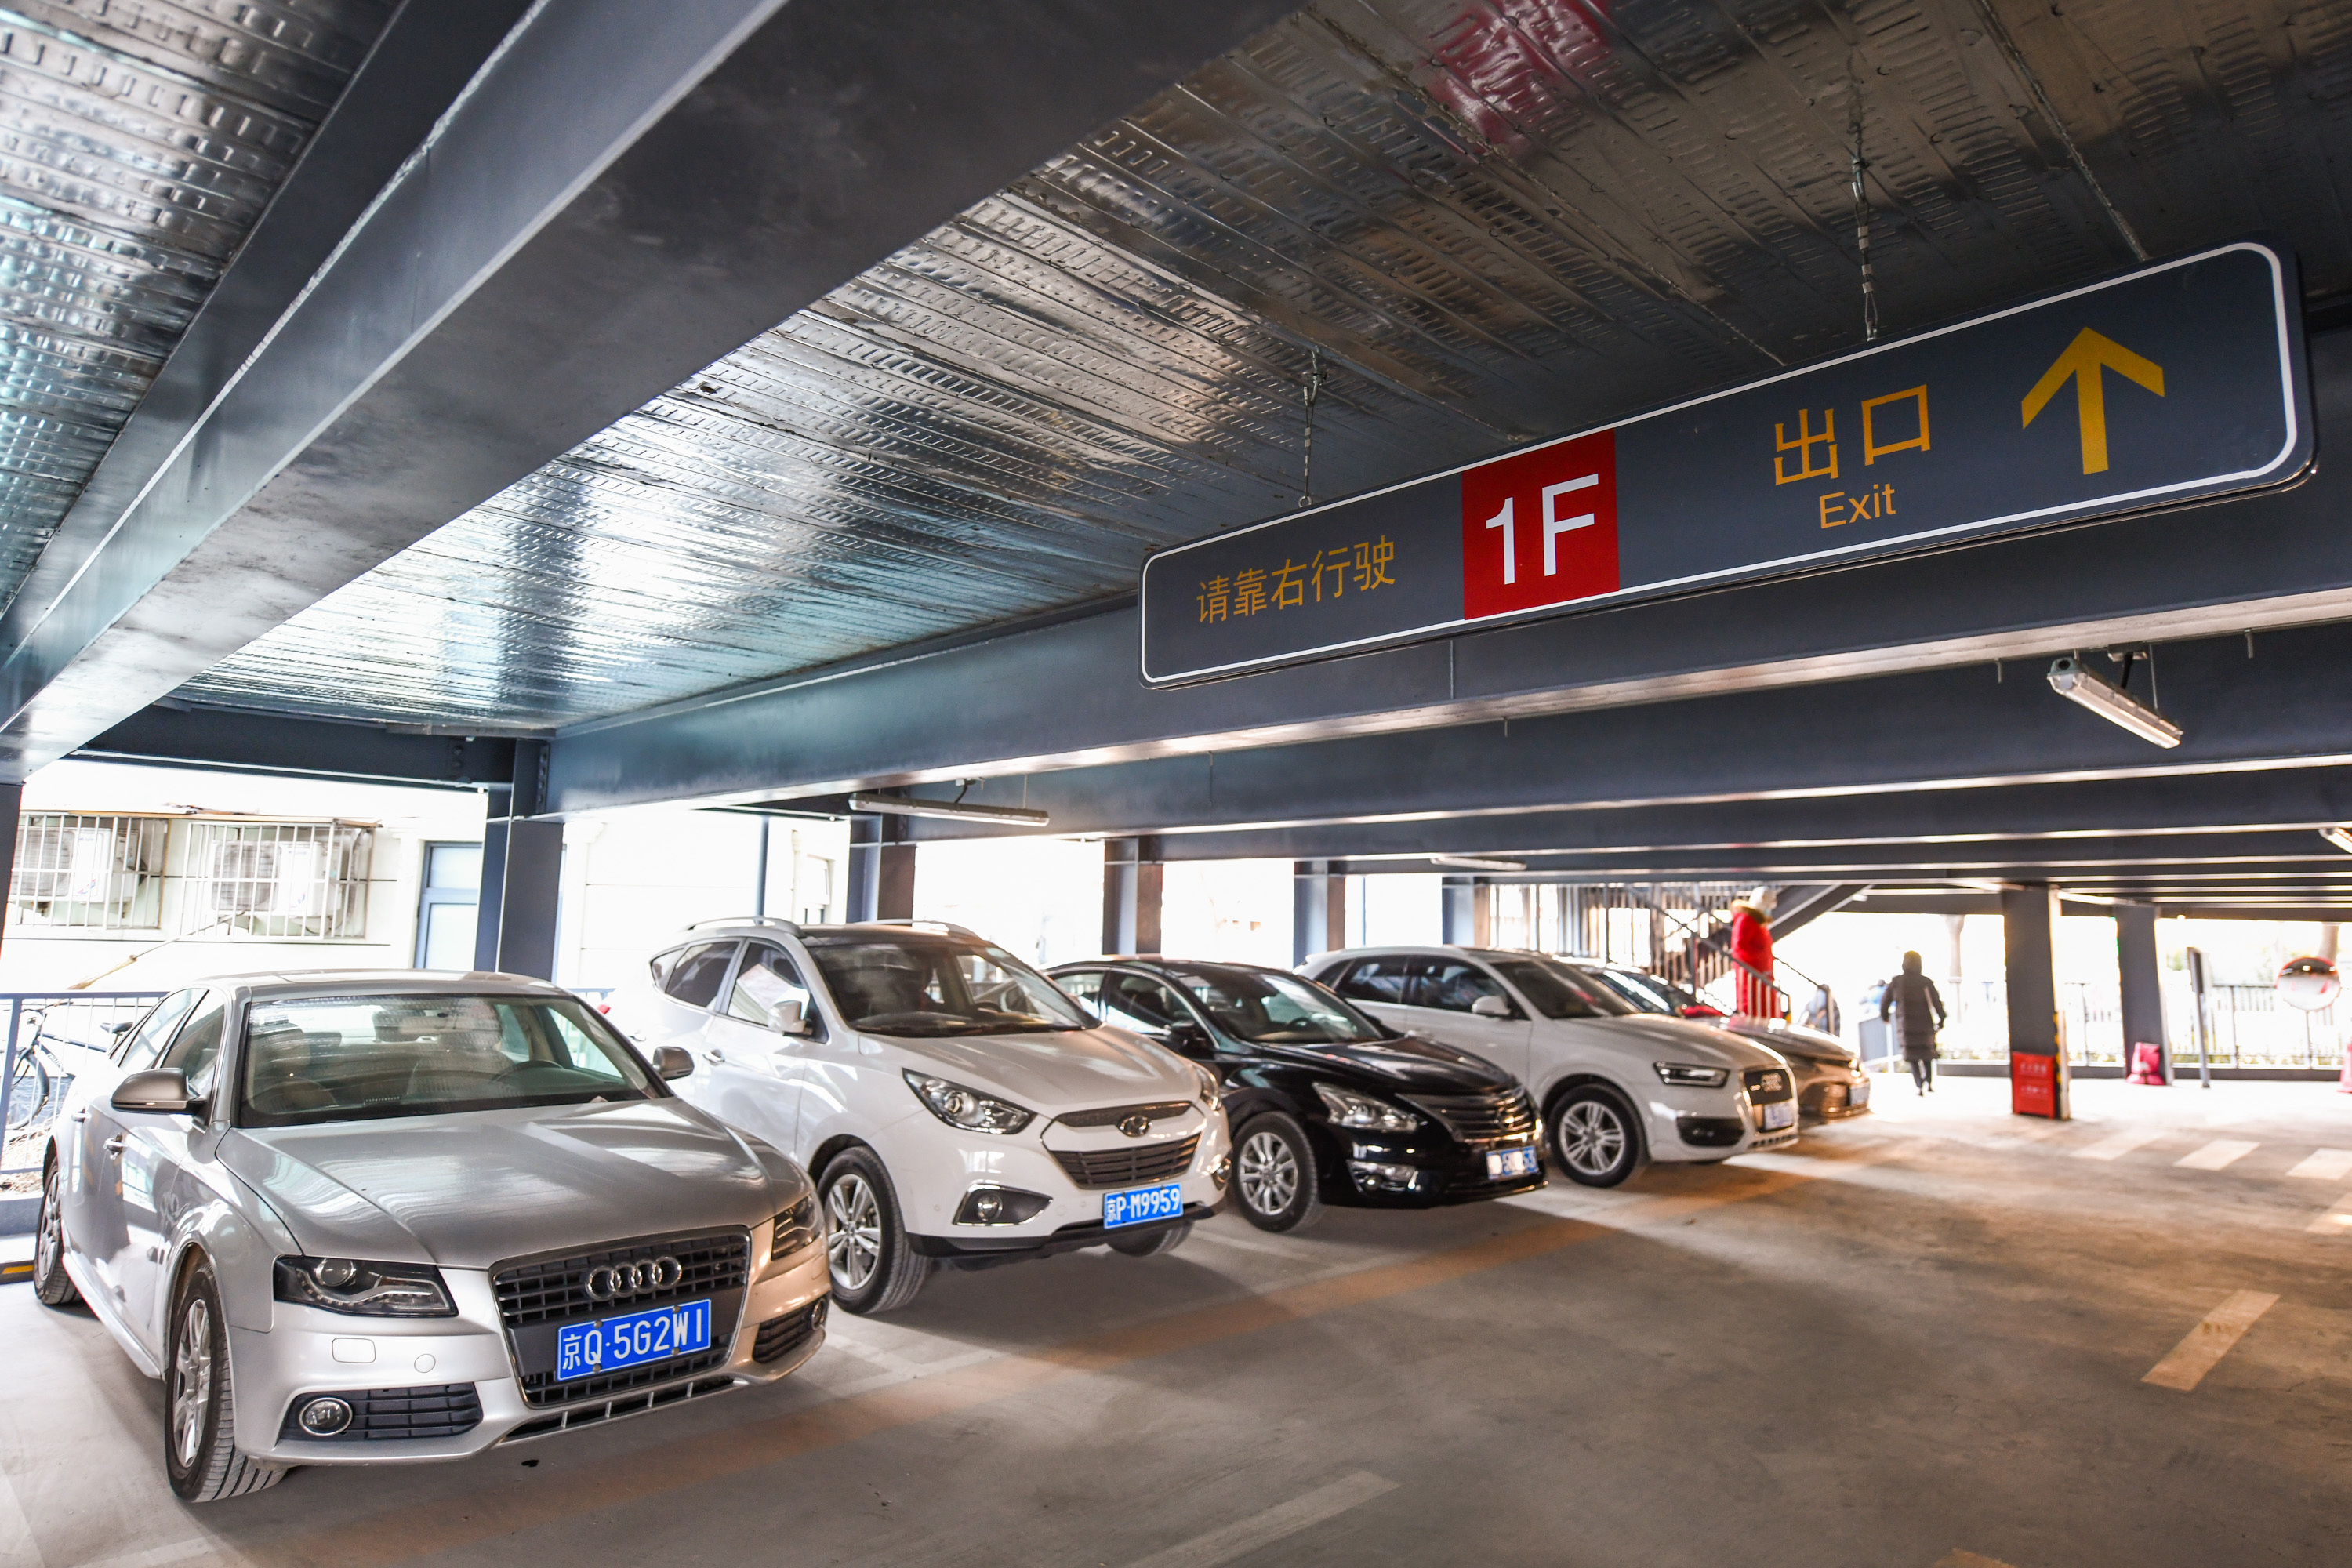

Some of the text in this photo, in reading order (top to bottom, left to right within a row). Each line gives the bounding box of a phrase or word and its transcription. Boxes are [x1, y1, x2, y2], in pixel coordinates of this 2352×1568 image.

[1774, 383, 1930, 486] 出口
[1486, 473, 1599, 585] 1F
[1820, 483, 1896, 528] Exit
[1196, 535, 1395, 624] 请靠右行驶
